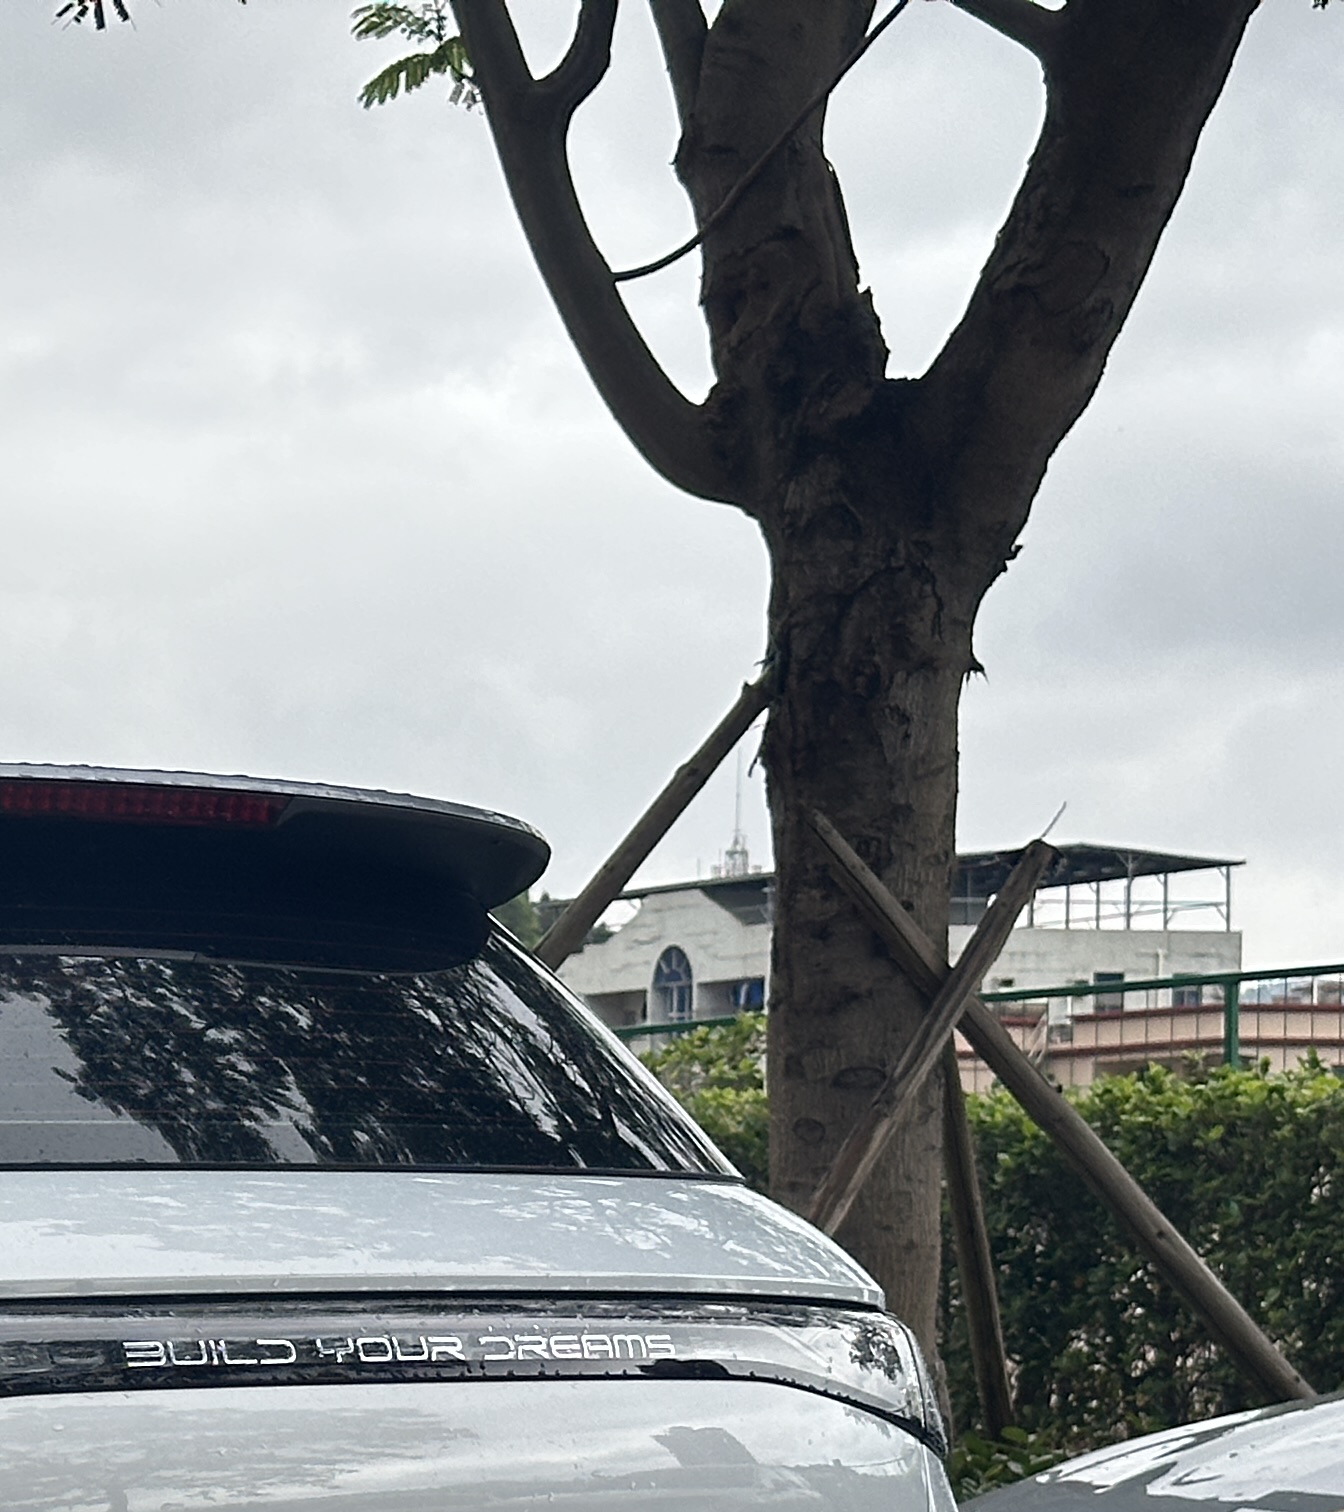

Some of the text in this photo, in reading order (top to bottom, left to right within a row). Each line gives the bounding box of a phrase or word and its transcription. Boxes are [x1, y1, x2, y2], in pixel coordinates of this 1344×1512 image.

[123, 1334, 676, 1367] BUILD YOUR DREAMS
